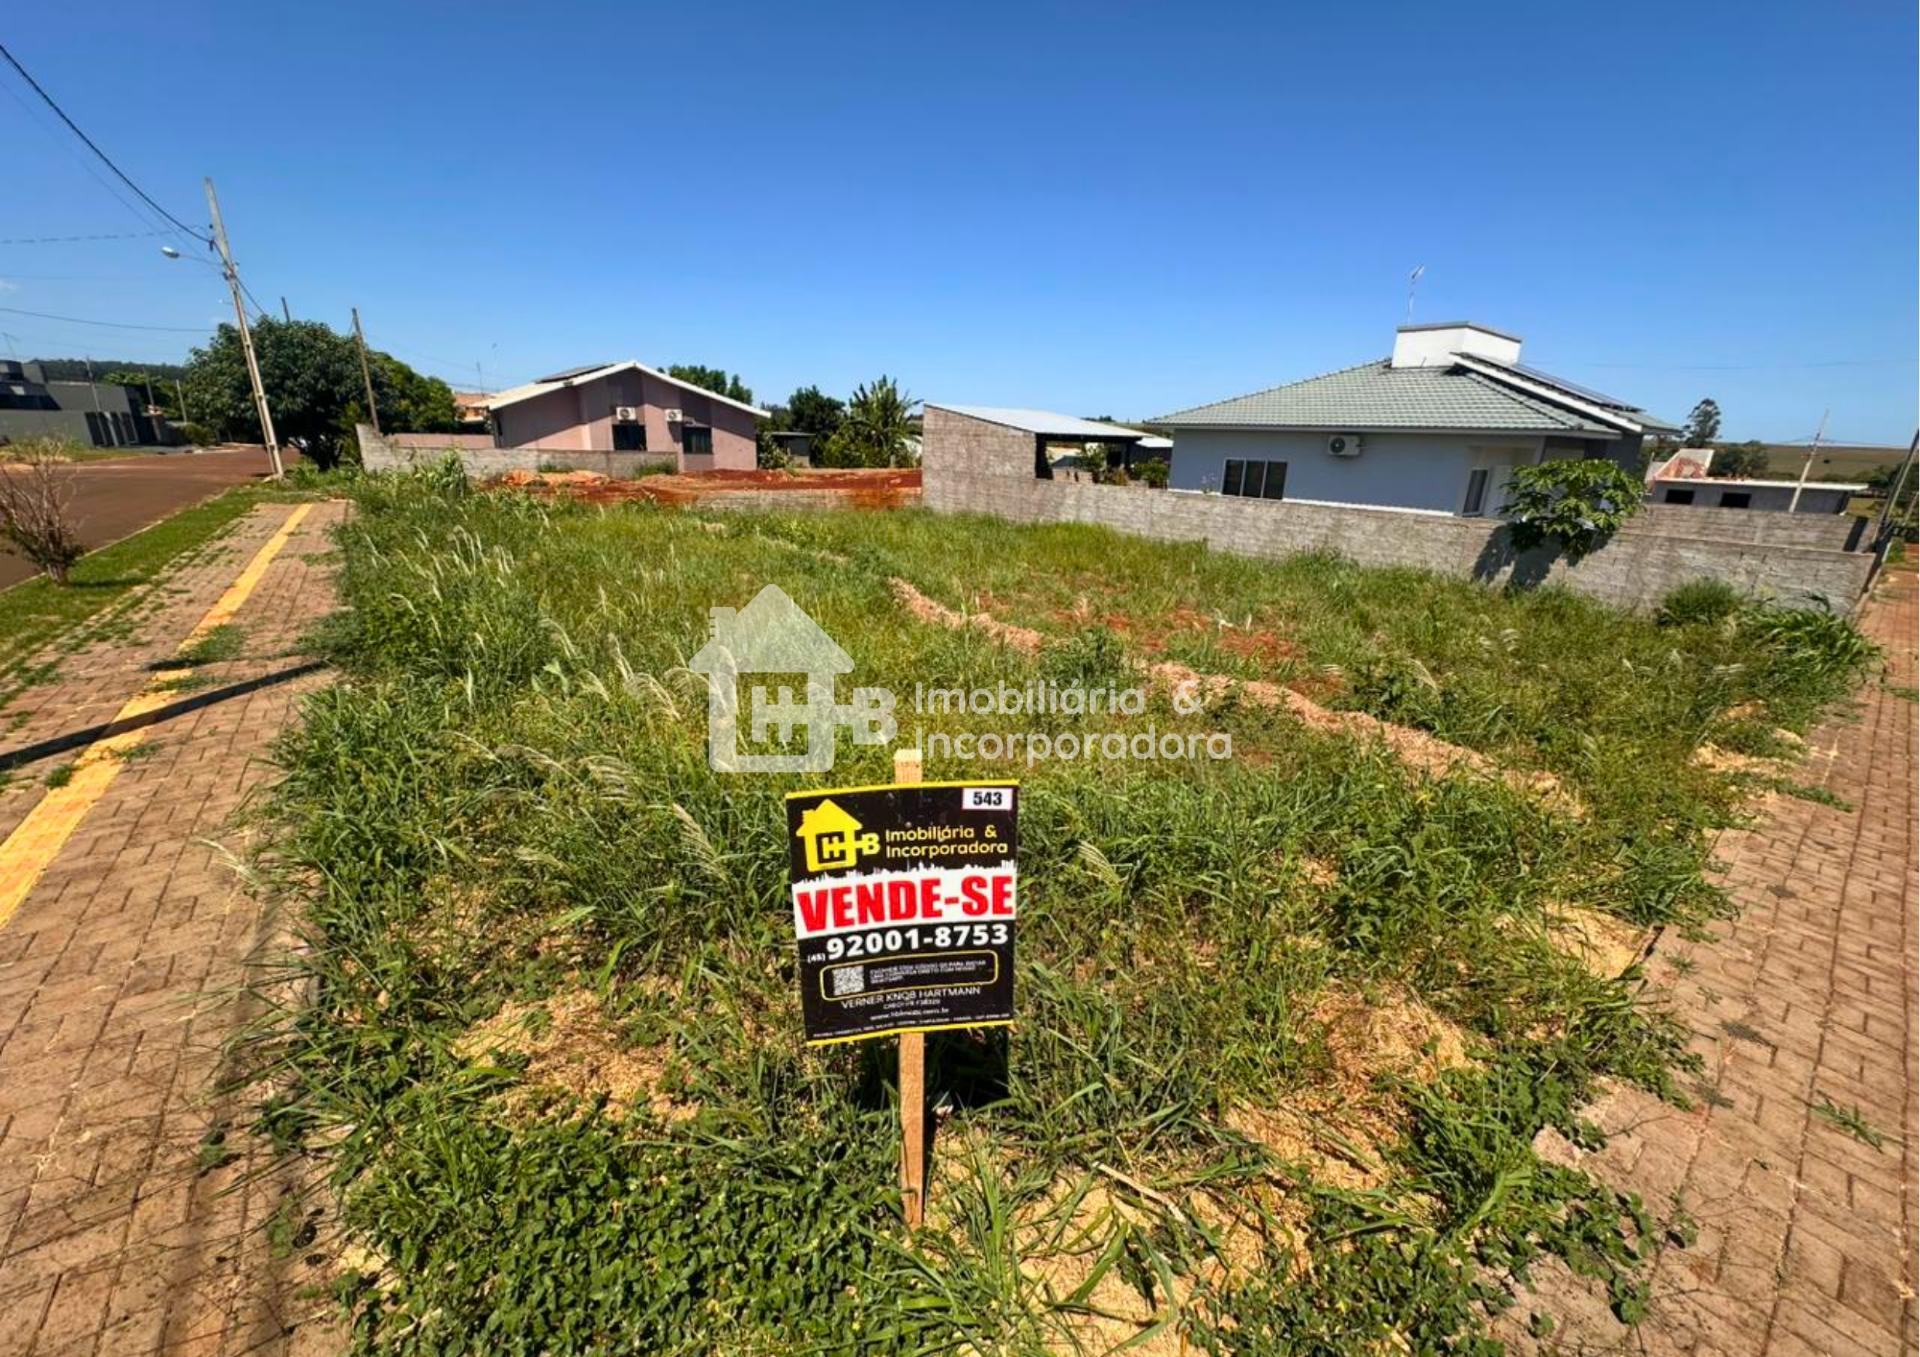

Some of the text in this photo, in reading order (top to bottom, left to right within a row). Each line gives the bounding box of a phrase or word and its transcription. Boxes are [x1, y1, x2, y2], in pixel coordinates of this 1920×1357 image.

[972, 791, 1003, 807] 543
[885, 824, 998, 842] Imobiliária &
[886, 840, 1009, 859] Incorporadora
[796, 875, 1014, 932] VENDE-SE
[826, 923, 1009, 960] 92001-8753
[840, 994, 884, 1009] VERNER
[919, 986, 981, 999] HARTMANN
